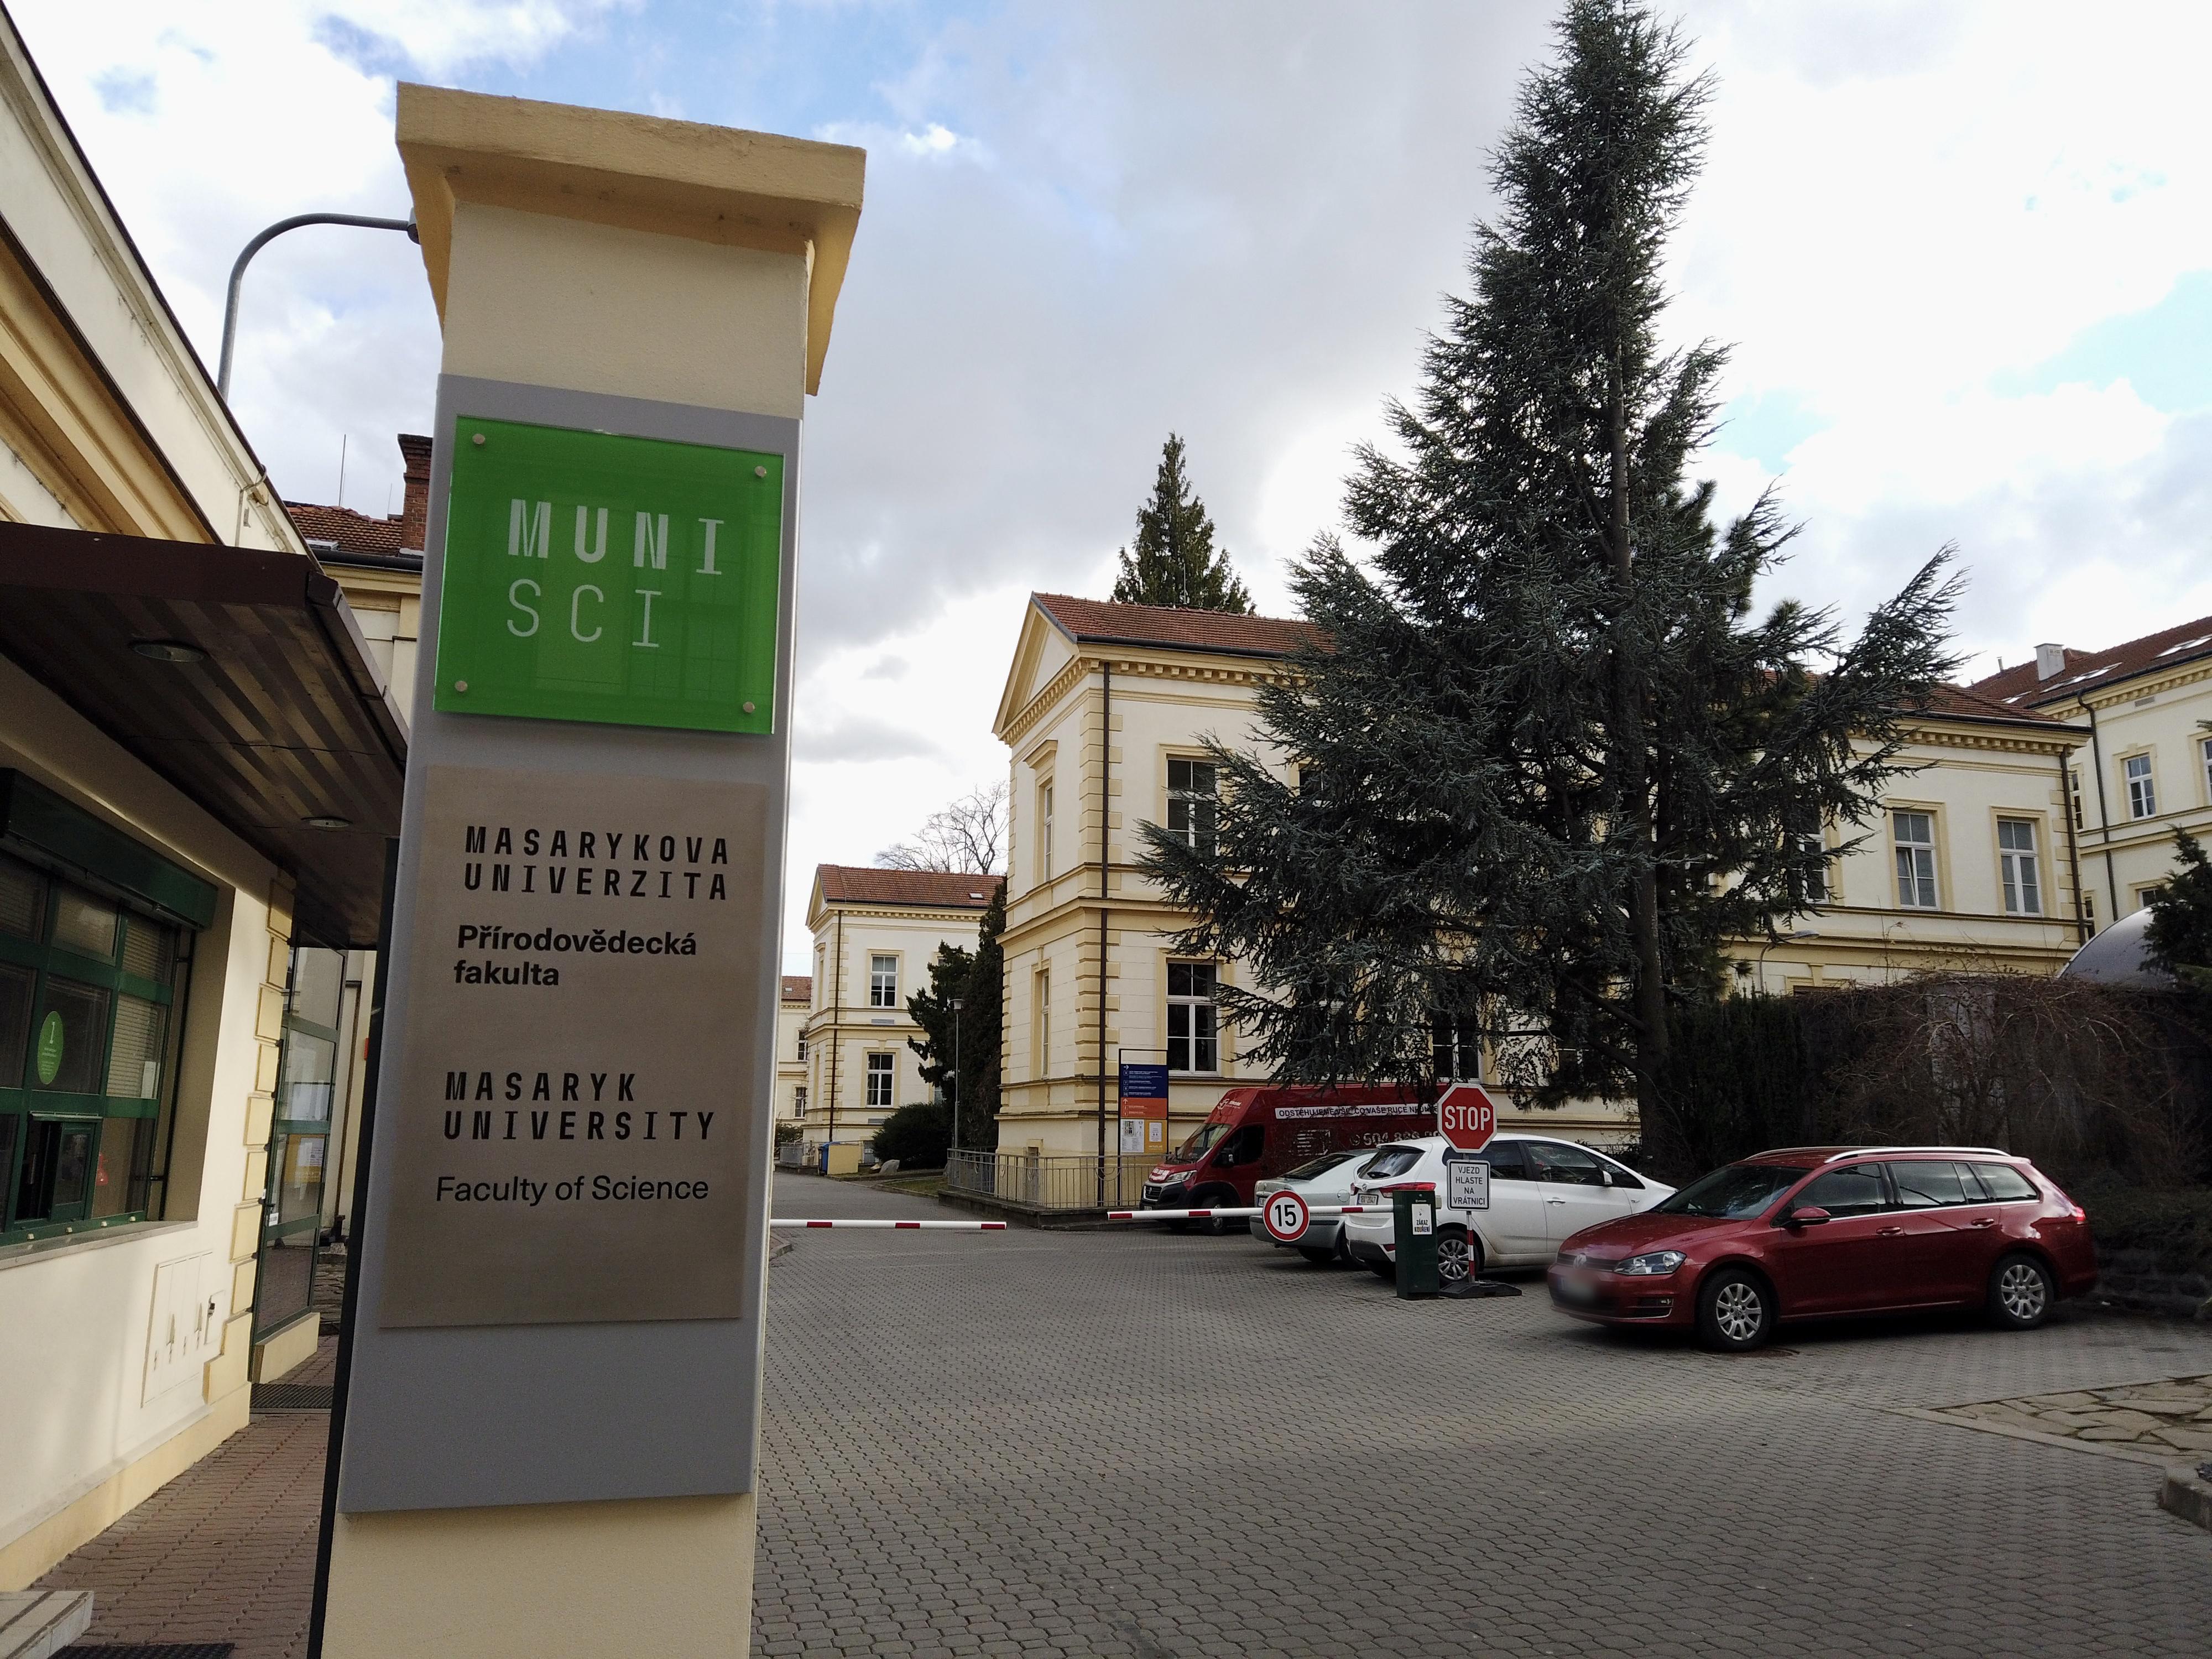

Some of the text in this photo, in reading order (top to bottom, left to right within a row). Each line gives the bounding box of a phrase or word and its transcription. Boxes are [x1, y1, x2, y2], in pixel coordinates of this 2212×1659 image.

[508, 499, 724, 575] MUNI
[507, 578, 662, 648] SCI
[465, 826, 728, 864] MASARYKOVA
[464, 863, 726, 900] UNIVERZITA
[458, 925, 696, 955] Přírodovědecká
[454, 960, 559, 985] fakulta
[445, 1072, 635, 1102] MASARYK
[444, 1111, 714, 1140] UNIVERSITY
[1444, 1105, 1491, 1131] STOP
[1458, 1166, 1480, 1175] VJEZD
[436, 1175, 709, 1207] Faculty of Science
[1453, 1196, 1485, 1206] VRÁTNICI
[1275, 1204, 1297, 1227] 15
